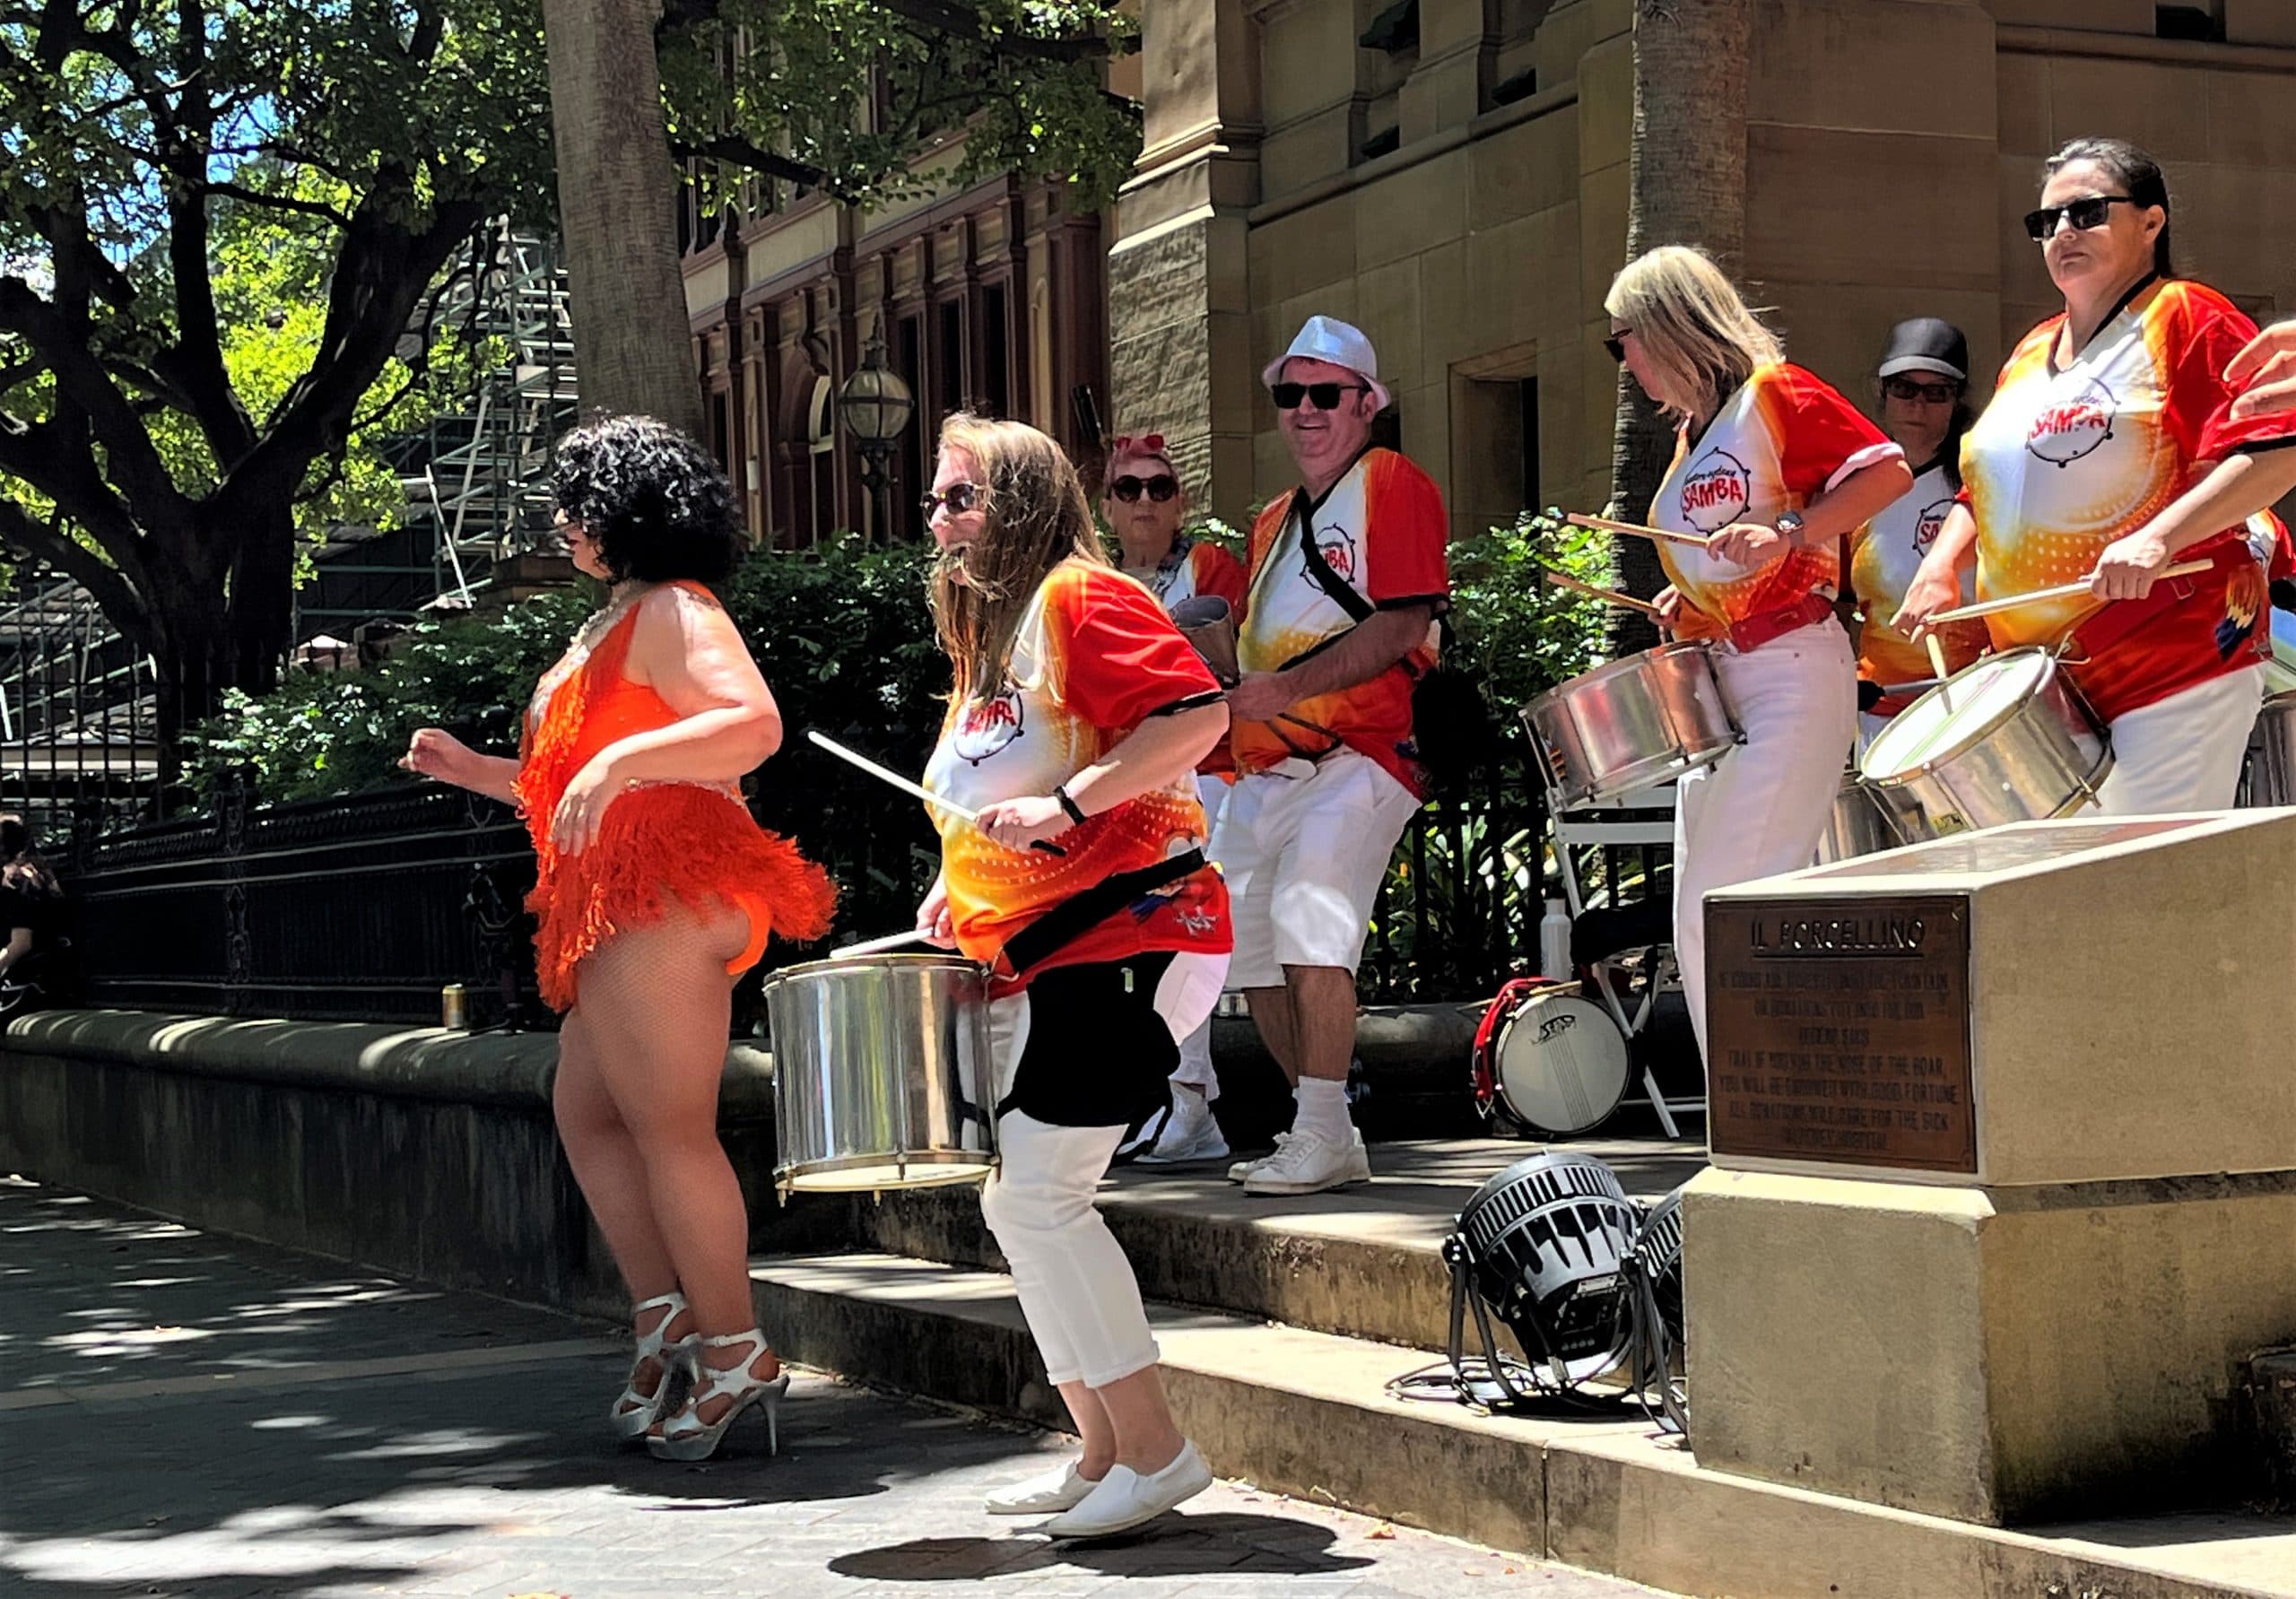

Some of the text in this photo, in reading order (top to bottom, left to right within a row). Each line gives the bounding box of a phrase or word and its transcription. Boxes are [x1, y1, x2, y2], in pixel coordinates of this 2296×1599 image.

[1683, 477, 1744, 513] SAMBA
[1751, 918, 1926, 950] IL PORCELLINO
